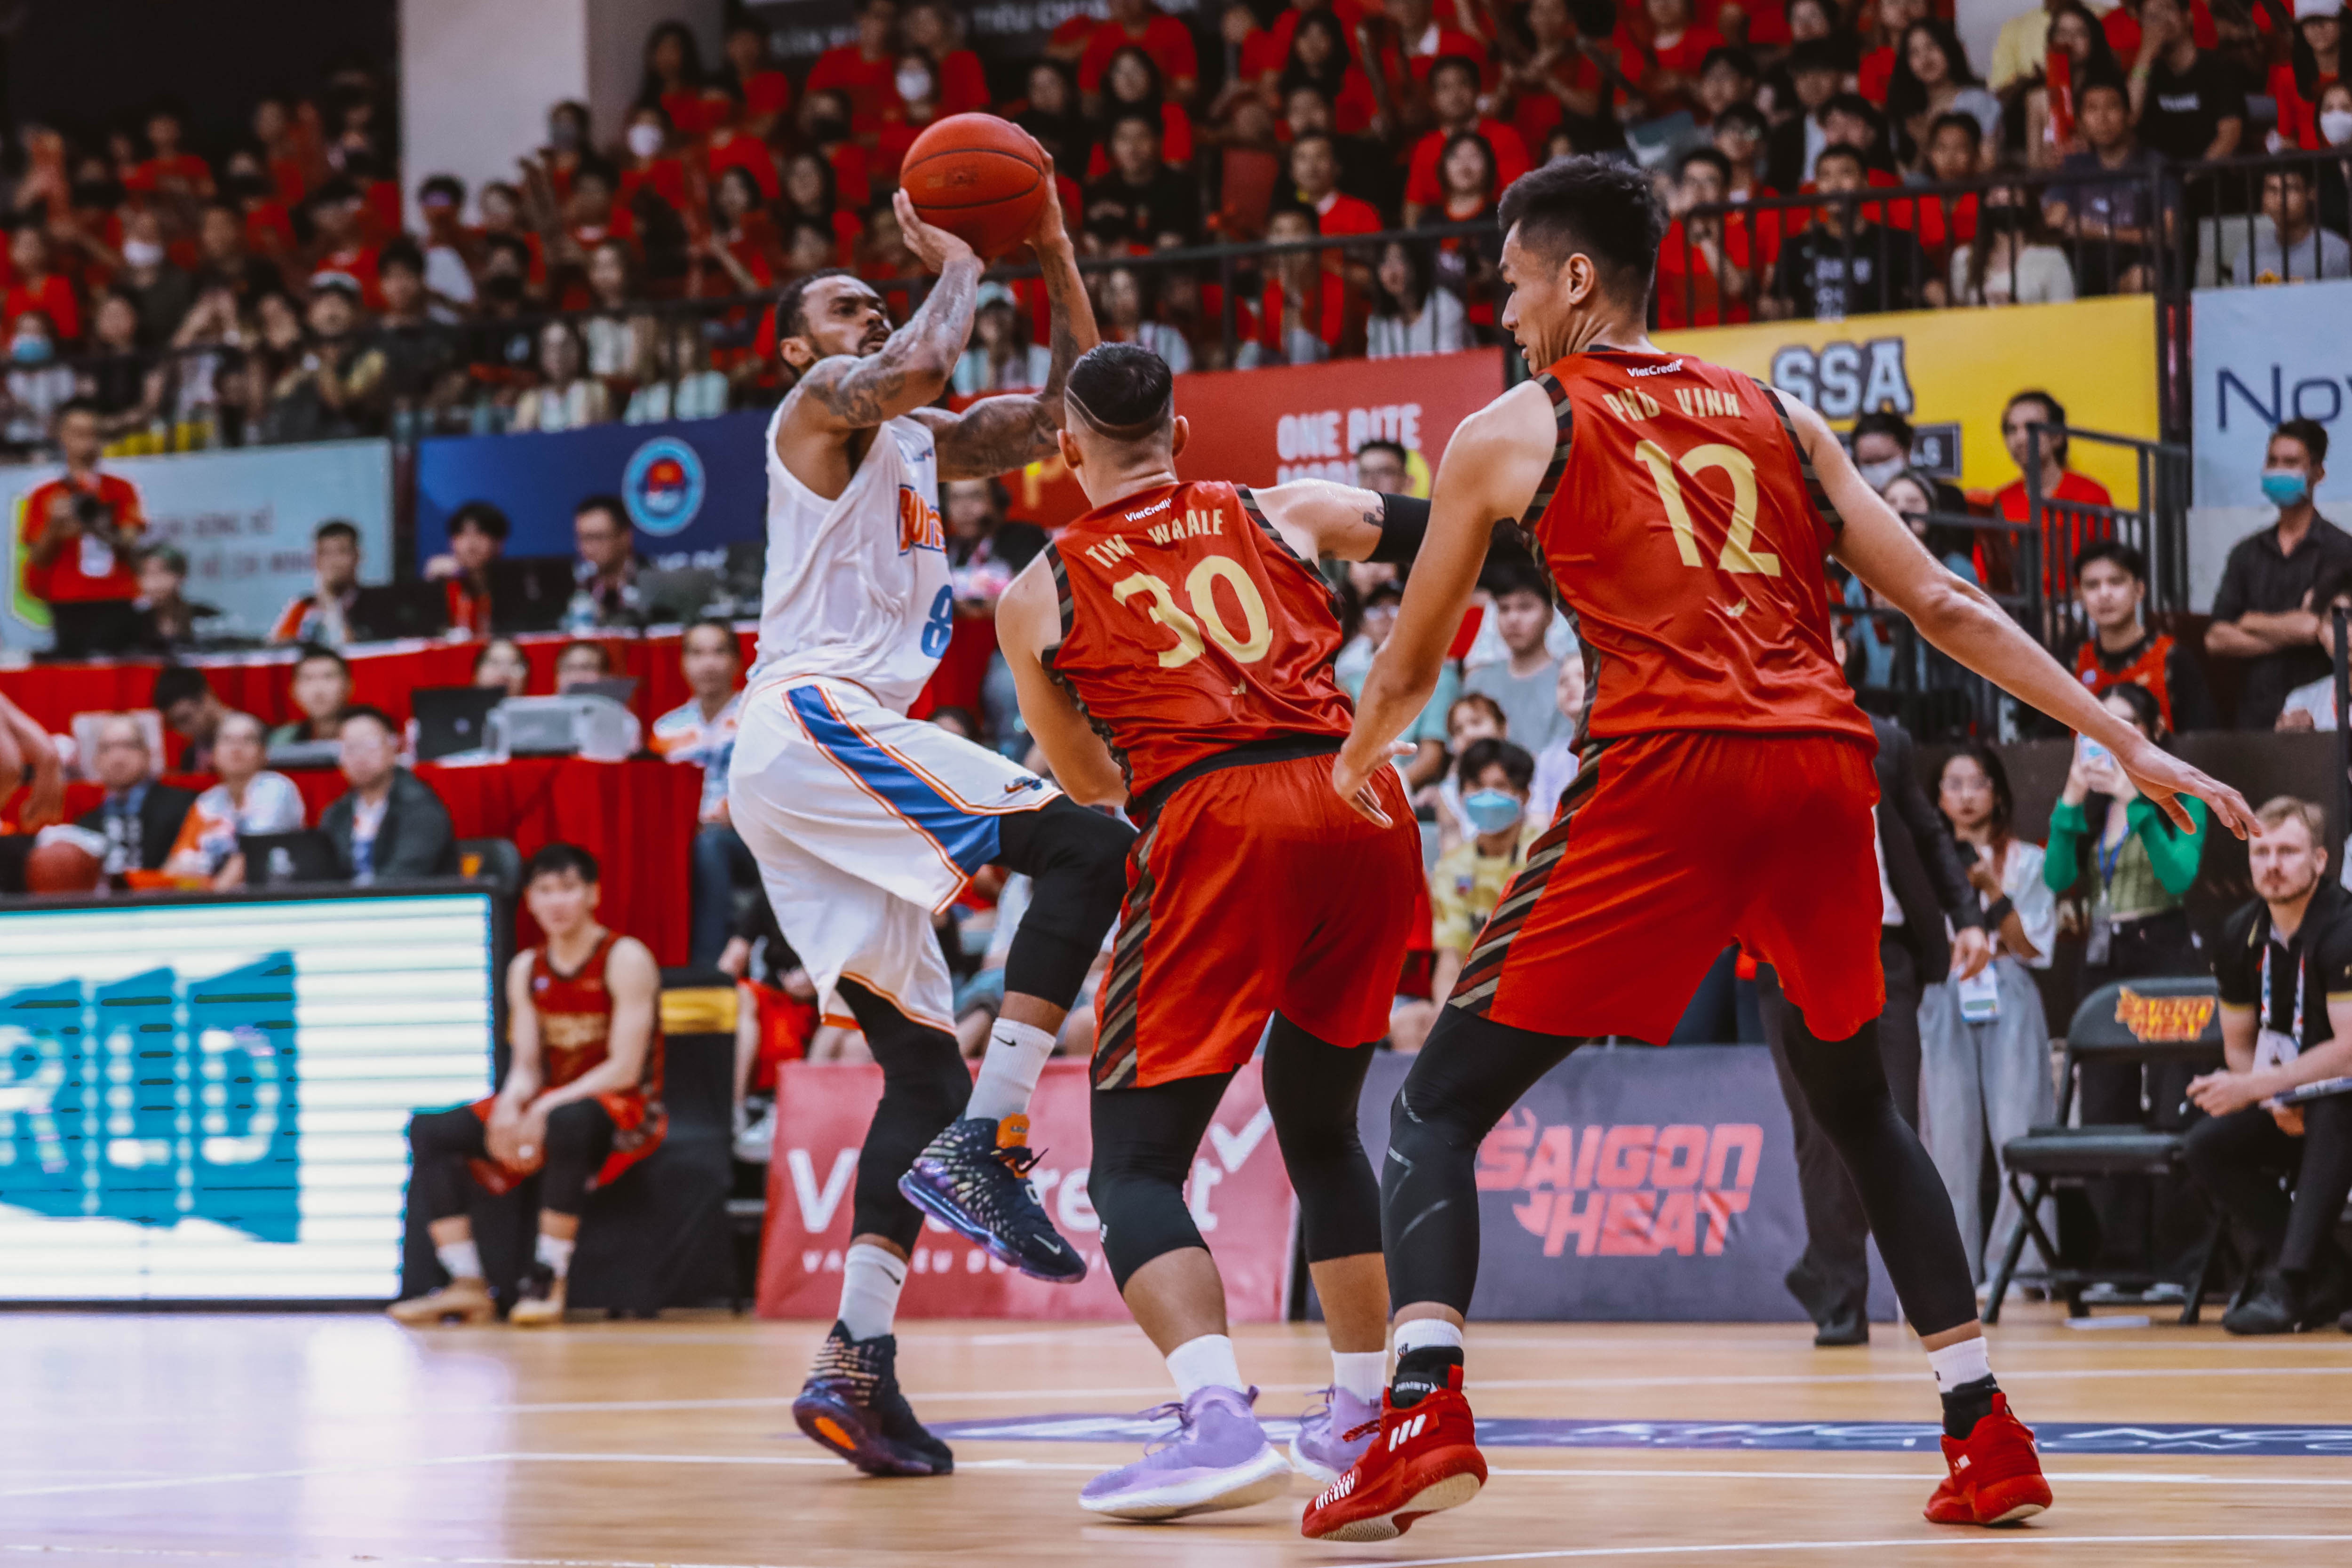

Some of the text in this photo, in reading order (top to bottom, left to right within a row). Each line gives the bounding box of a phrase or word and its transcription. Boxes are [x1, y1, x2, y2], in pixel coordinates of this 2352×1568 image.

[1627, 361, 1682, 377] VietCredit
[1674, 387, 1740, 417] VINH
[1772, 339, 1914, 417] SSA
[2217, 362, 2352, 432] No
[1276, 409, 1342, 461] ONE
[1085, 508, 1223, 569] TIM WAALE
[1635, 439, 1781, 578] 12
[921, 584, 954, 660] 8
[1112, 555, 1273, 668] 30
[1474, 1122, 1764, 1191] SAIGON
[1542, 1189, 1751, 1257] HEAT
